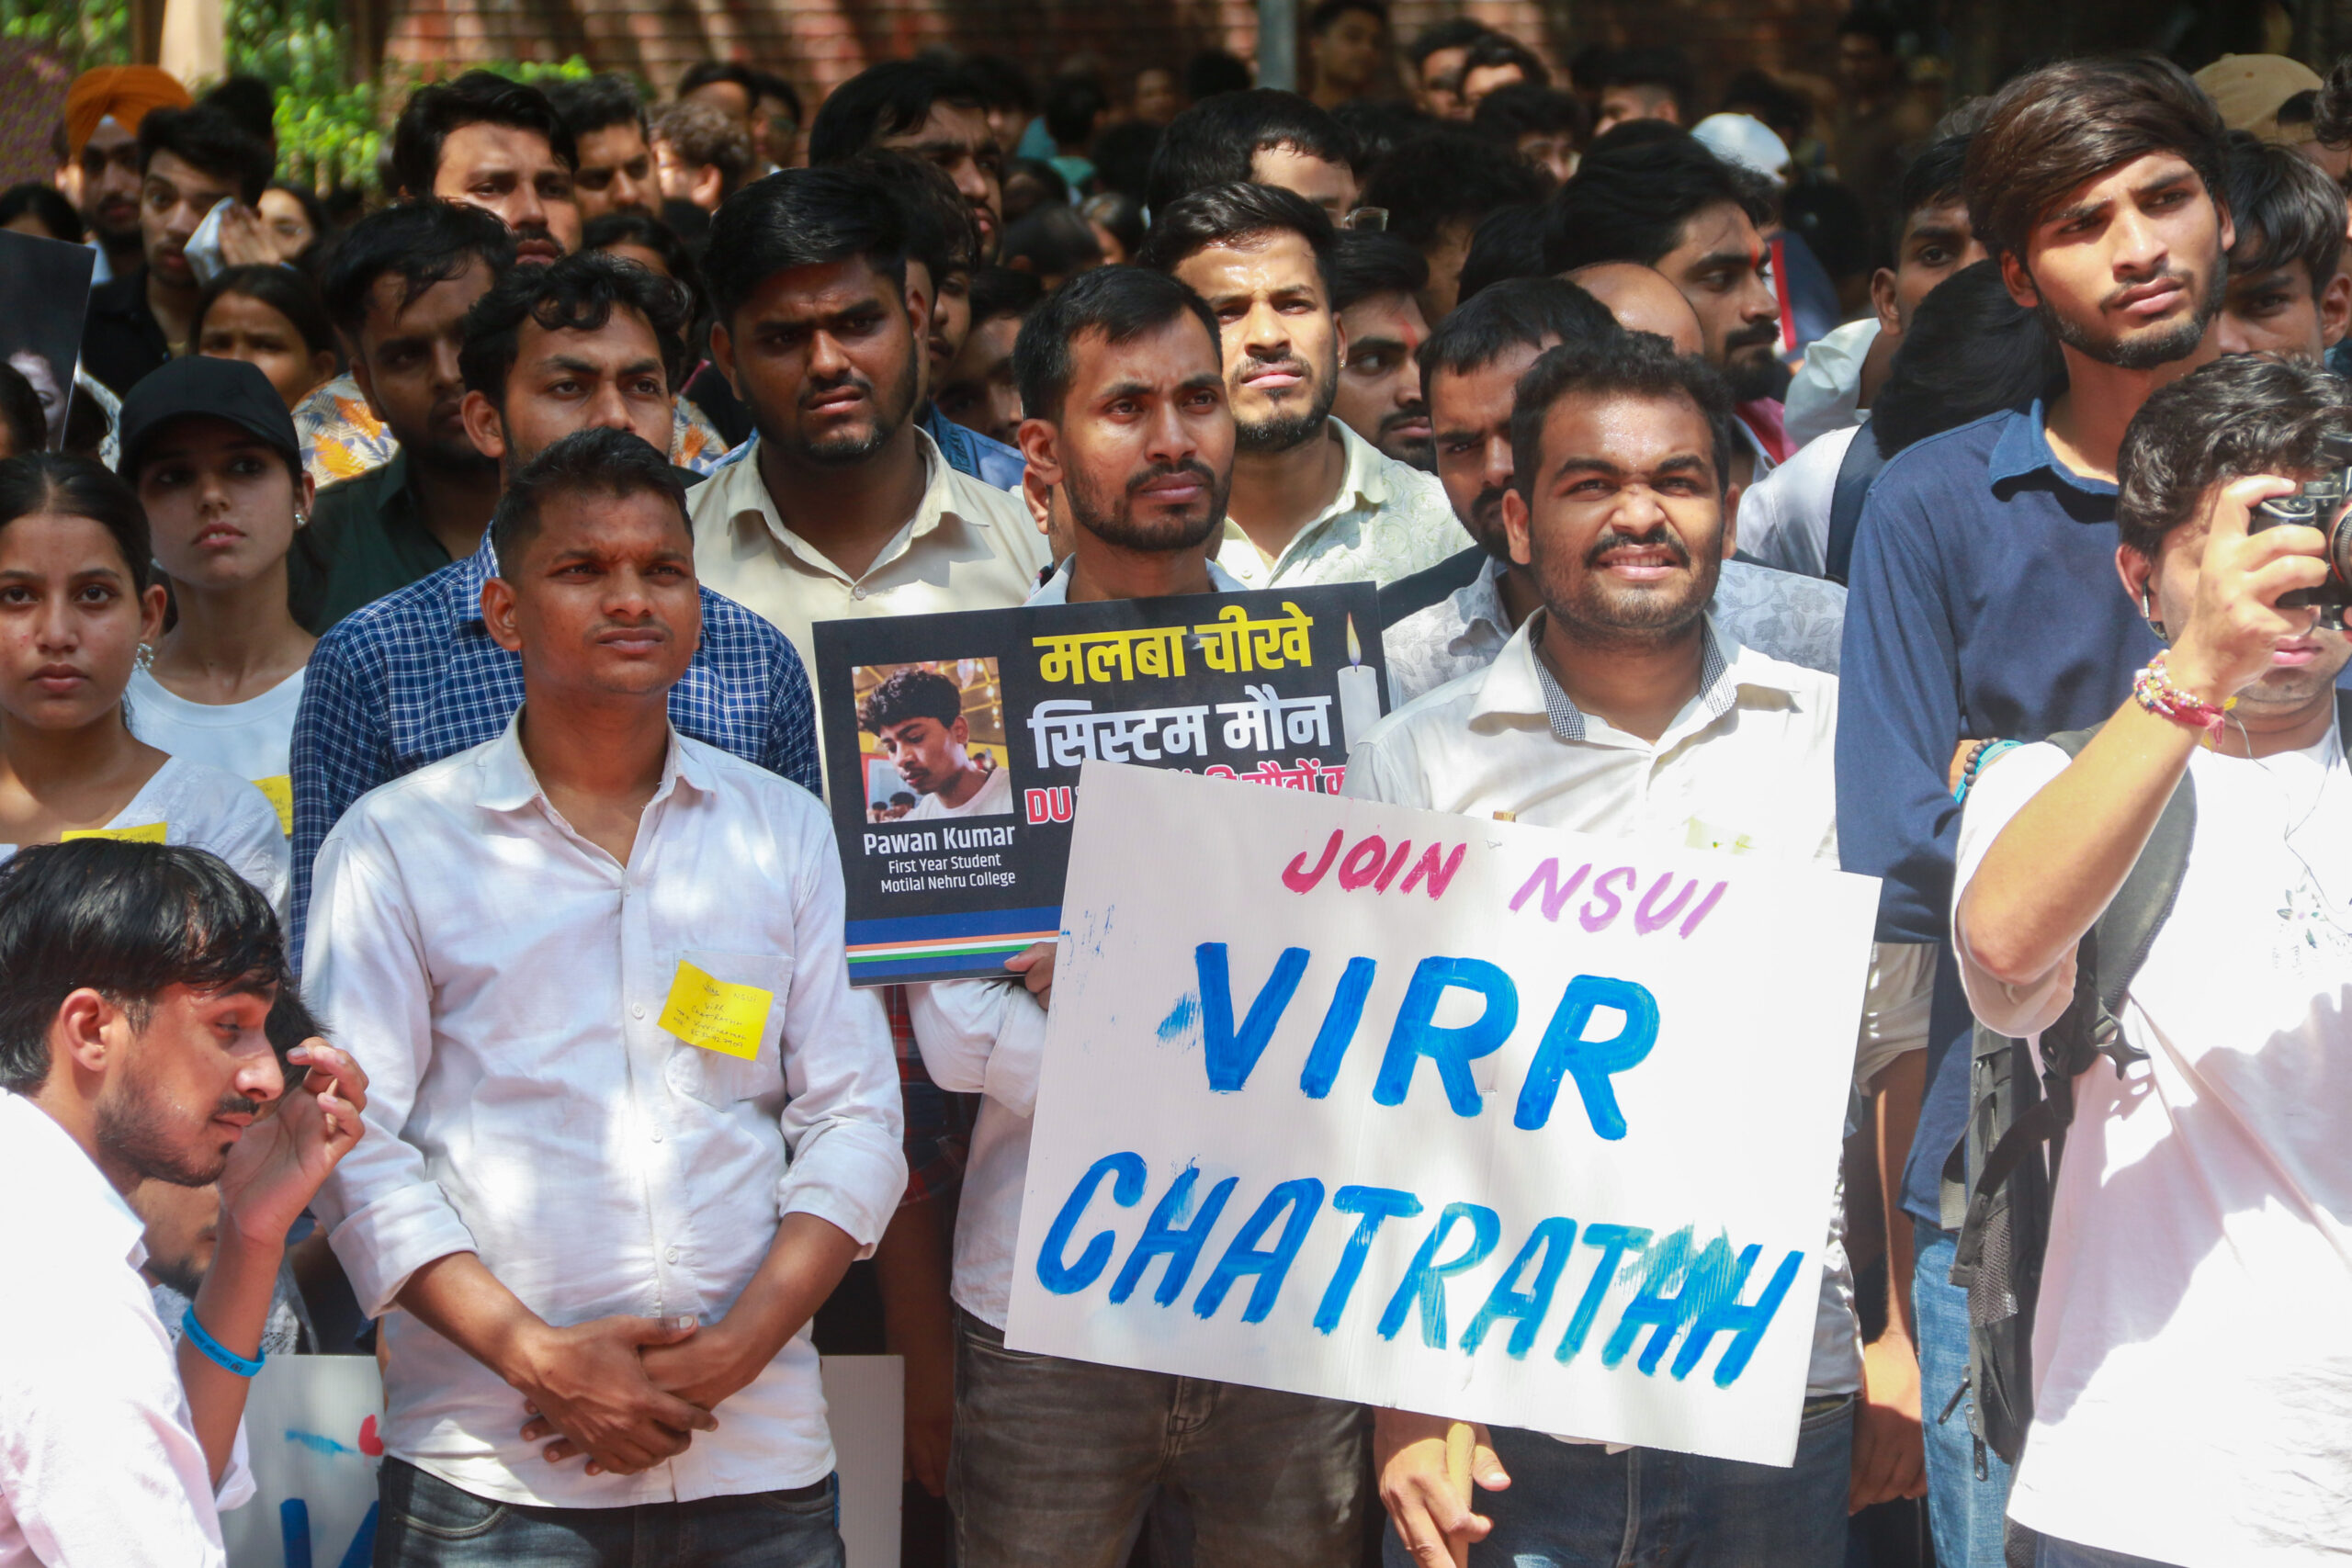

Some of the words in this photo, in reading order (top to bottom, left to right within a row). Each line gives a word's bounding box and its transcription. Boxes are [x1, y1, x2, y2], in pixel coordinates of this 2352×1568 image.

[1032, 626, 1187, 684] मलबा
[1193, 602, 1314, 673] चीखे
[1026, 700, 1209, 769] सिस्टम
[1216, 683, 1332, 751] मौन
[1024, 786, 1073, 824] DU
[863, 830, 937, 855] Pawan
[943, 825, 1016, 851] Kumar
[888, 859, 917, 874] First
[919, 857, 948, 872] Year
[951, 852, 1001, 870] Student
[880, 876, 925, 894] Motilal
[928, 874, 967, 890] Nehru
[969, 871, 1016, 887] College
[1282, 828, 1467, 901] JOIN
[1509, 857, 1728, 940] NSUI
[1194, 942, 1660, 1140] VIRR
